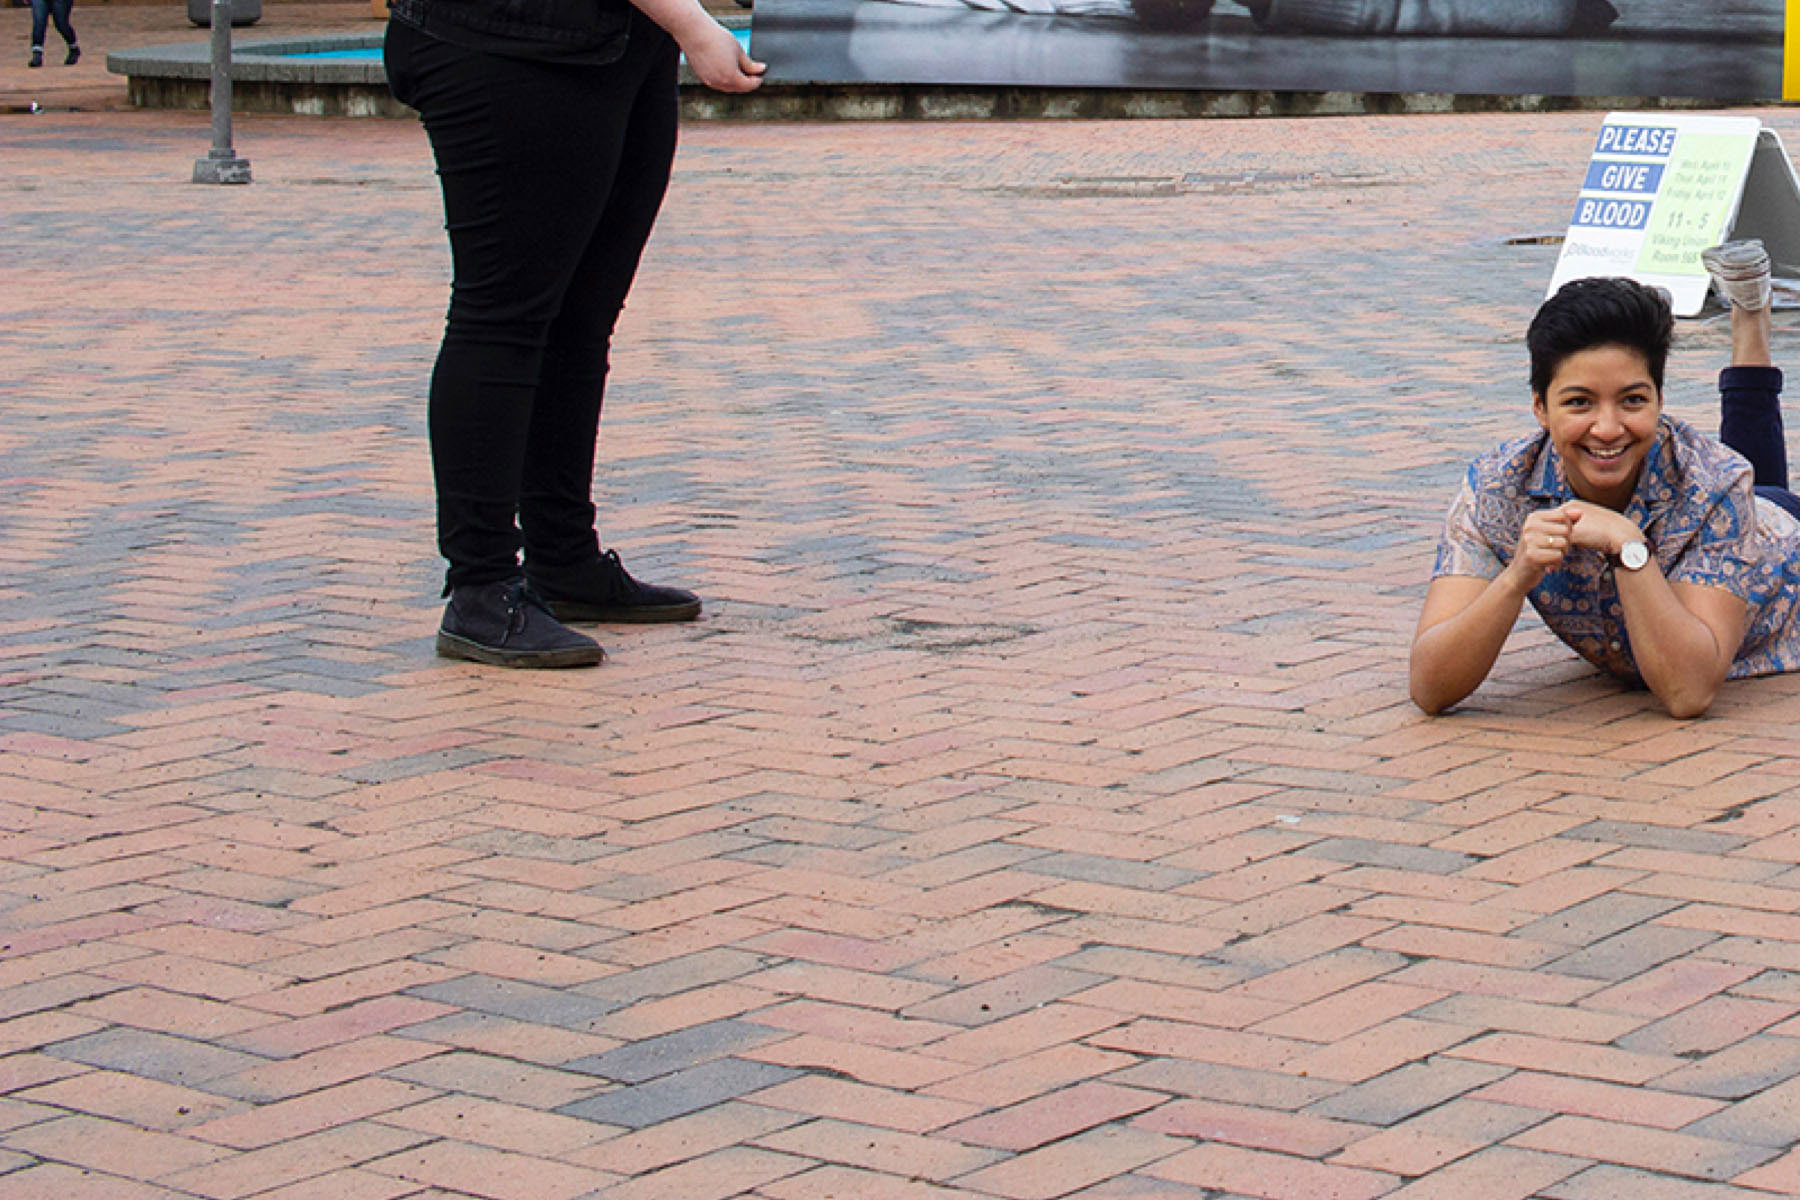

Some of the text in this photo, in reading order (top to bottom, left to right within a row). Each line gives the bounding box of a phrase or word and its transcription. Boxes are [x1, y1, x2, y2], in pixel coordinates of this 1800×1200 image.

[1599, 127, 1676, 153] PLEASE
[1601, 165, 1650, 190] GIVE
[1578, 200, 1645, 226] BLOOD
[1668, 211, 1683, 228] 11
[1698, 212, 1709, 229] 5
